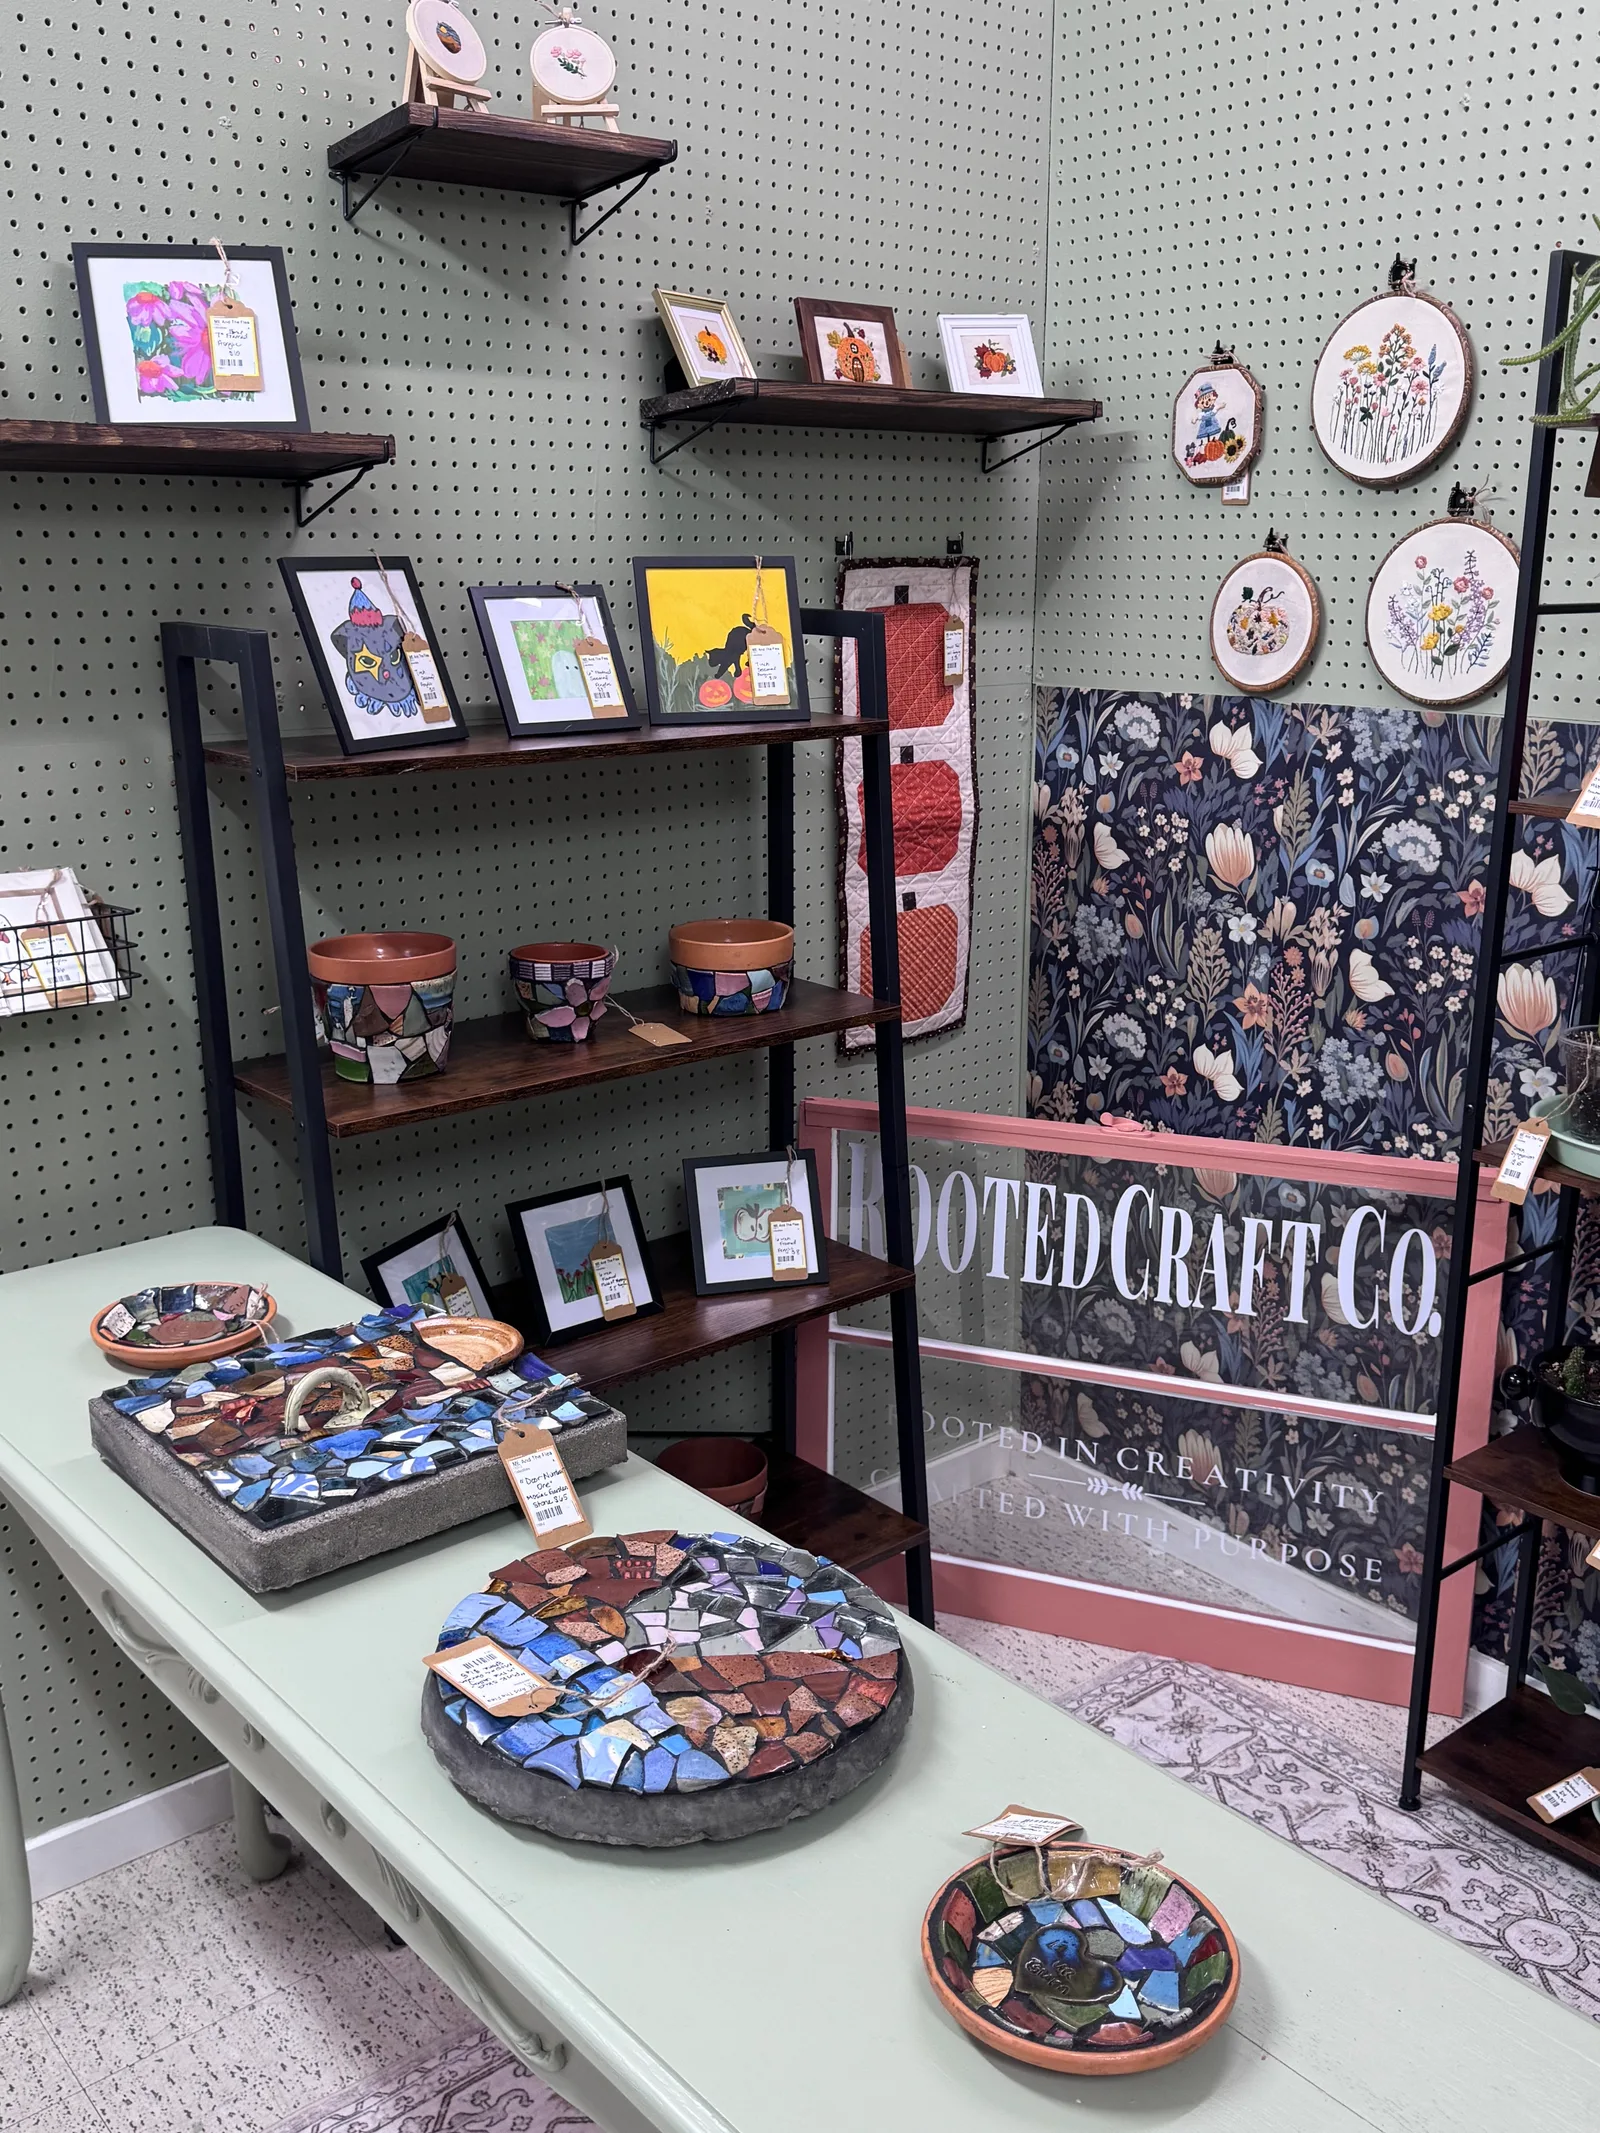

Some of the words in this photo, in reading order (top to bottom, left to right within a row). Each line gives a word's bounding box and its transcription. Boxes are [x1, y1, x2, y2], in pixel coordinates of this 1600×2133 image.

[1110, 1184, 1321, 1324] CRAFT
[1337, 1205, 1442, 1338] CO.
[1058, 1437, 1100, 1464] IN
[1116, 1447, 1384, 1514] CREATIVITY
[1064, 1502, 1170, 1543] WITH
[1194, 1527, 1383, 1583] PURPOSE
